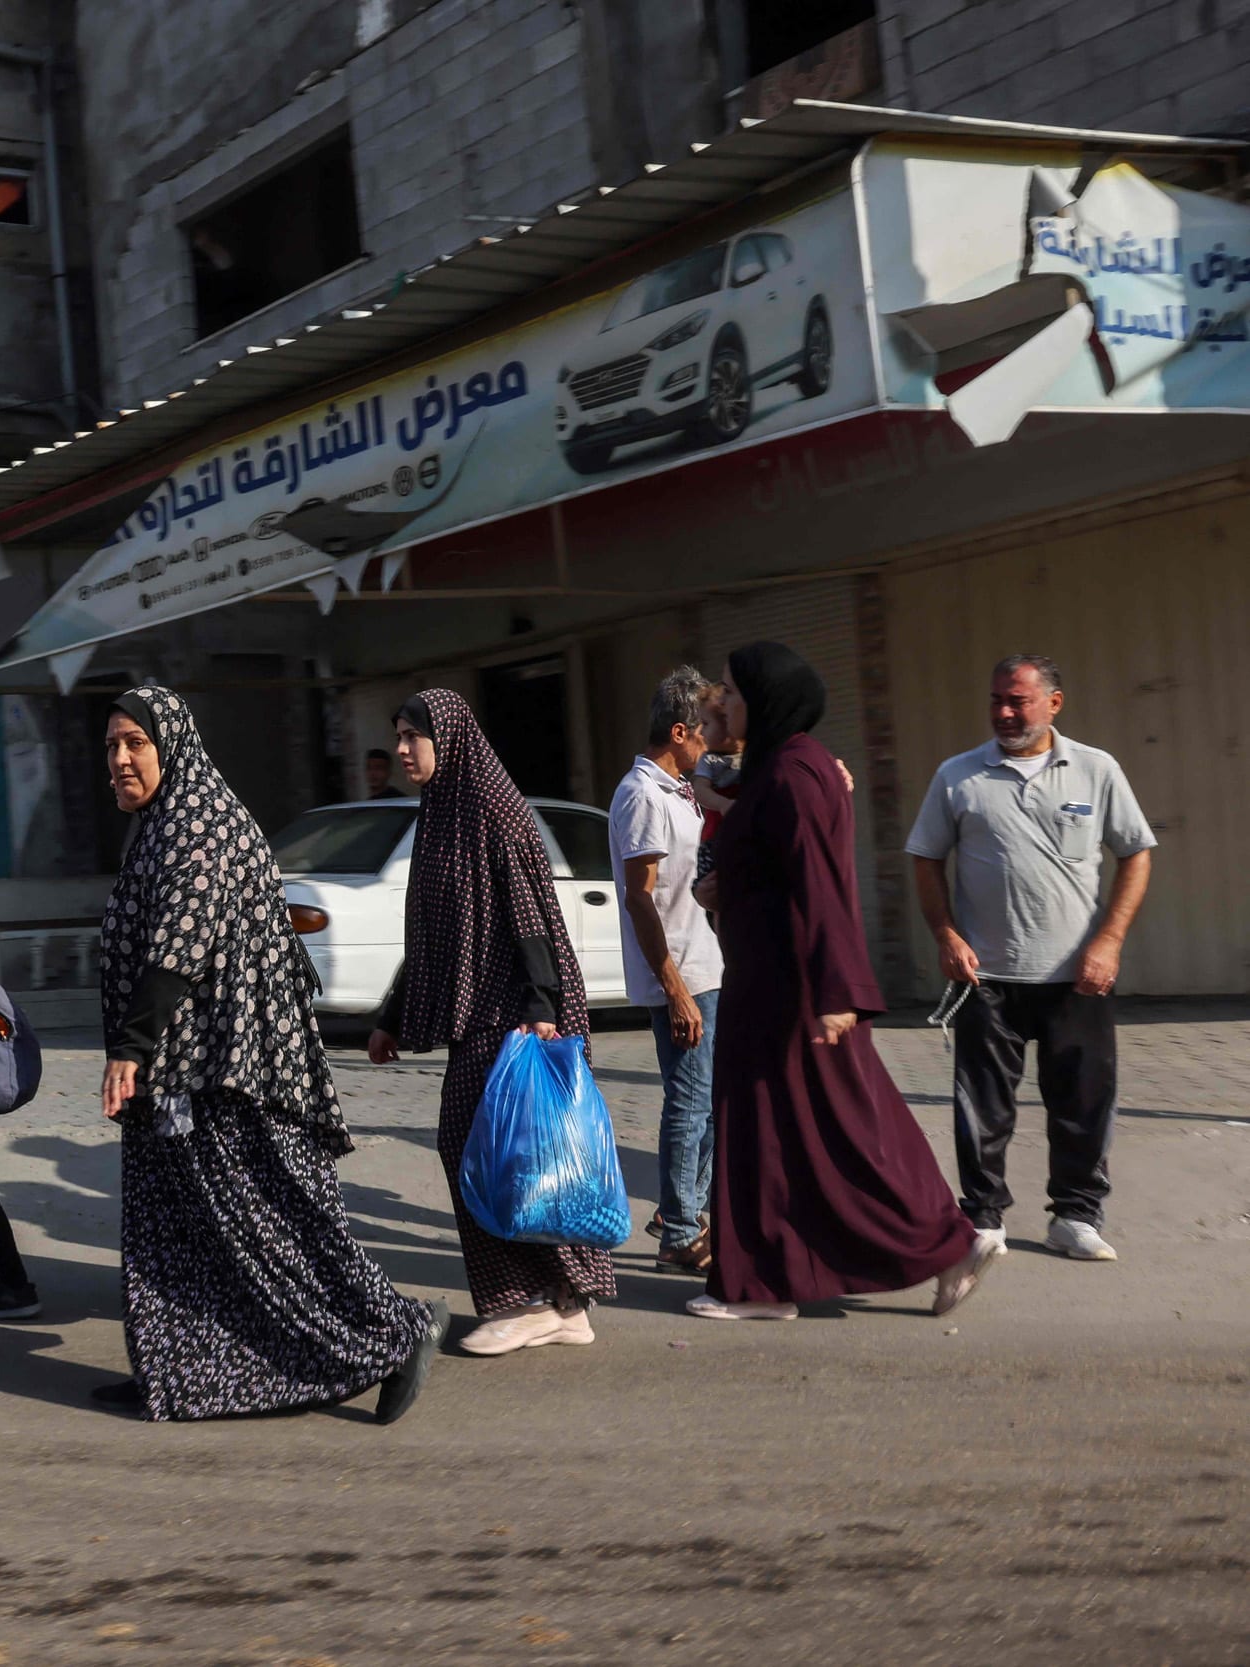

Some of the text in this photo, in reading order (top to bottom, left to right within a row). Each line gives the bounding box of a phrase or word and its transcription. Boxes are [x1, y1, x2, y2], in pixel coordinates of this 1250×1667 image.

[1094, 295, 1190, 345] السيا
[232, 396, 385, 494] الشارقة
[396, 361, 527, 450] معرض
